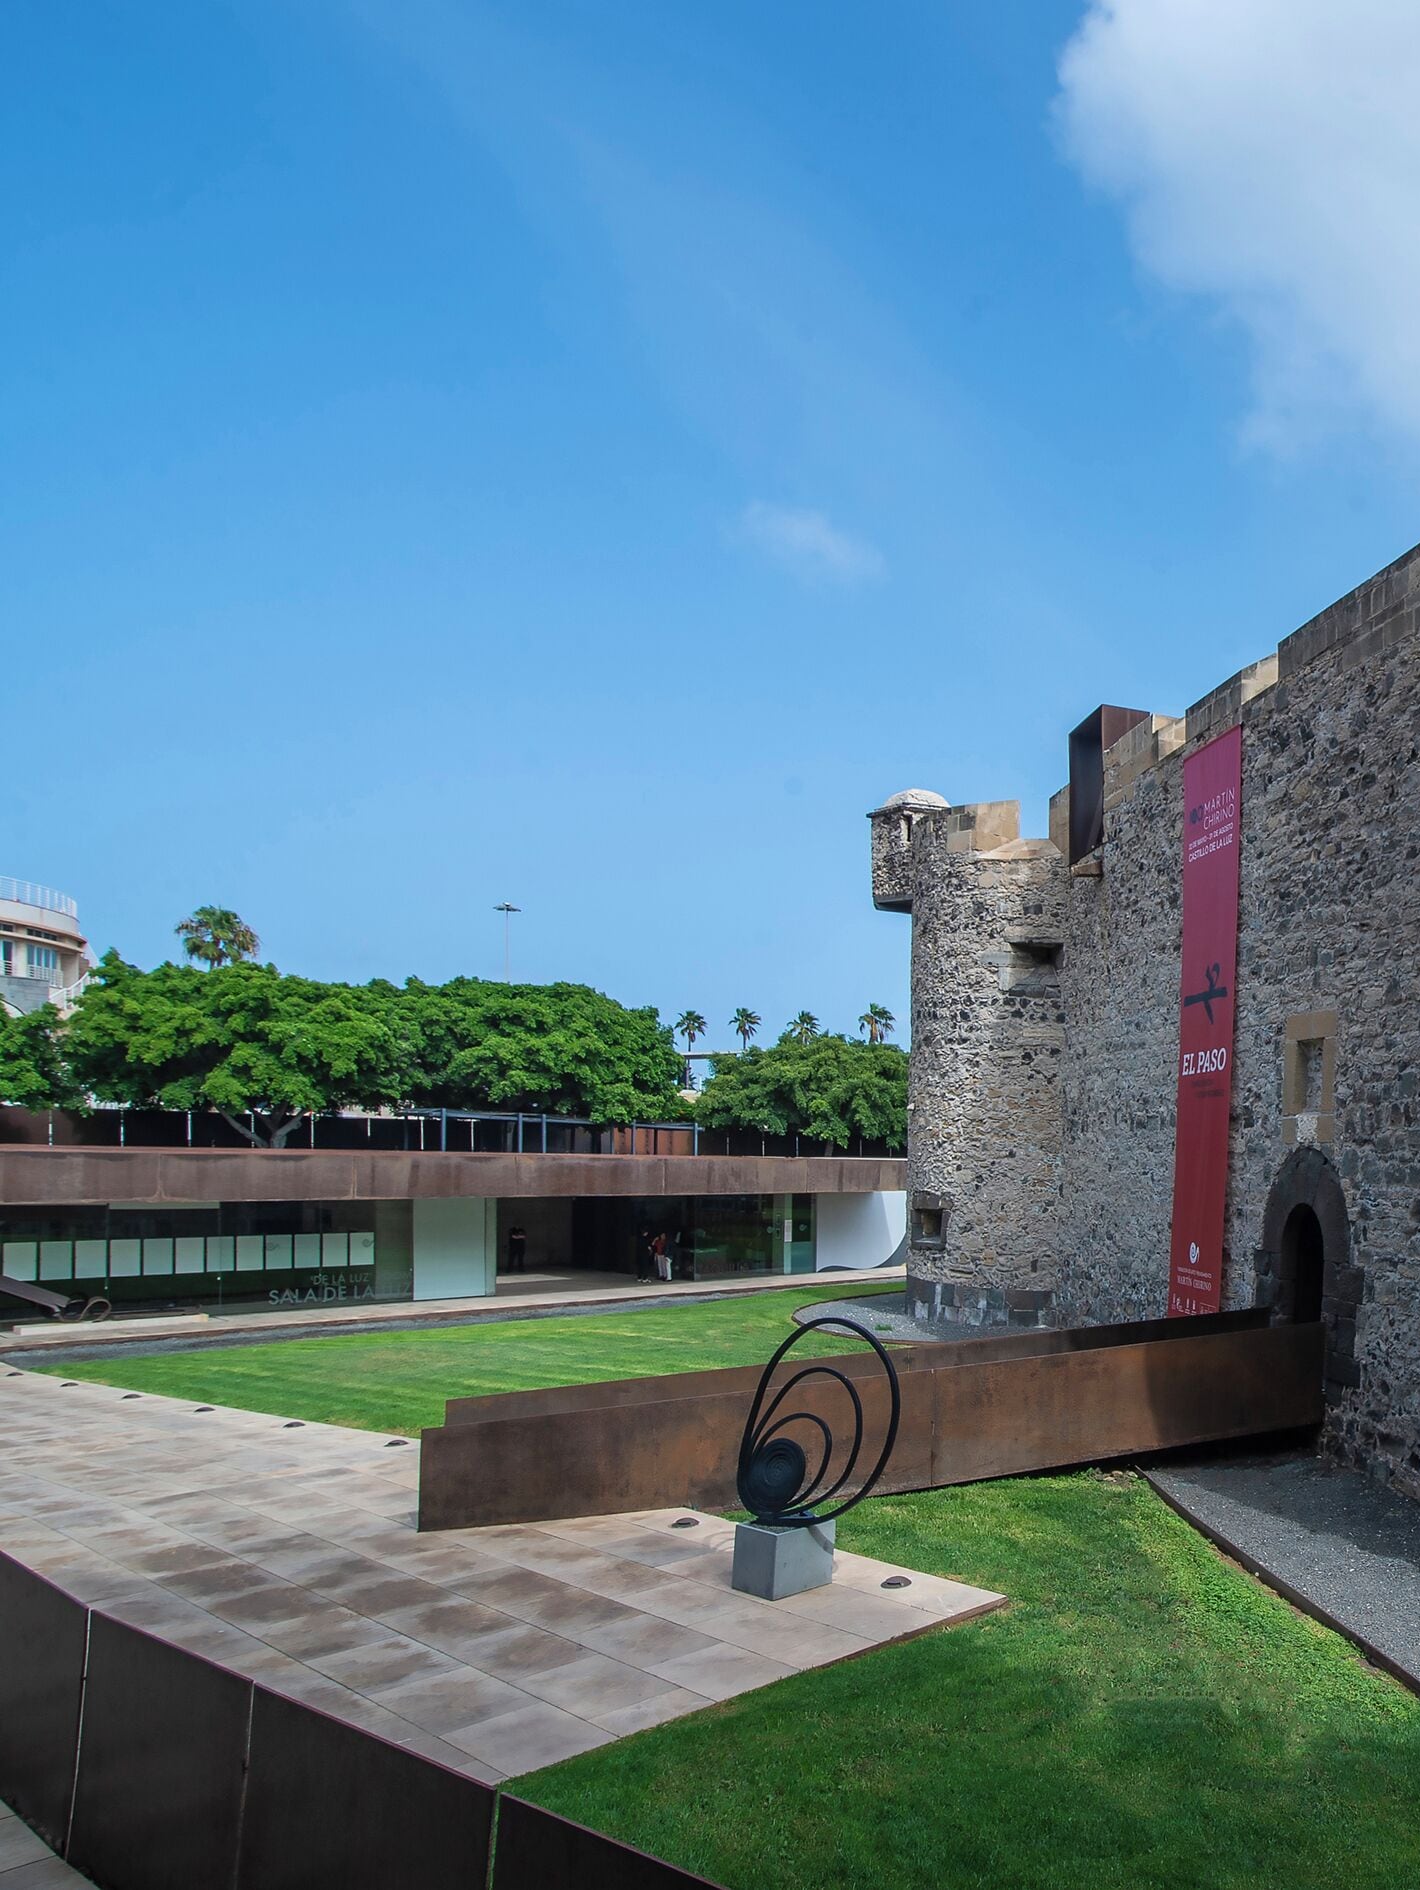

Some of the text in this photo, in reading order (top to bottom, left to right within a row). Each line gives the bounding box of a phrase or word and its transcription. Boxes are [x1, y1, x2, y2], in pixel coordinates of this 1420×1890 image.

[1203, 803, 1235, 830] CHIRINO
[1188, 833, 1233, 863] CASTILLO DE LA LUZ
[1182, 1047, 1227, 1076] EL PASO
[332, 1273, 346, 1285] LA
[349, 1272, 370, 1283] LUZ
[268, 1287, 317, 1306] SALA
[322, 1285, 347, 1303] DE
[353, 1284, 375, 1300] LA
